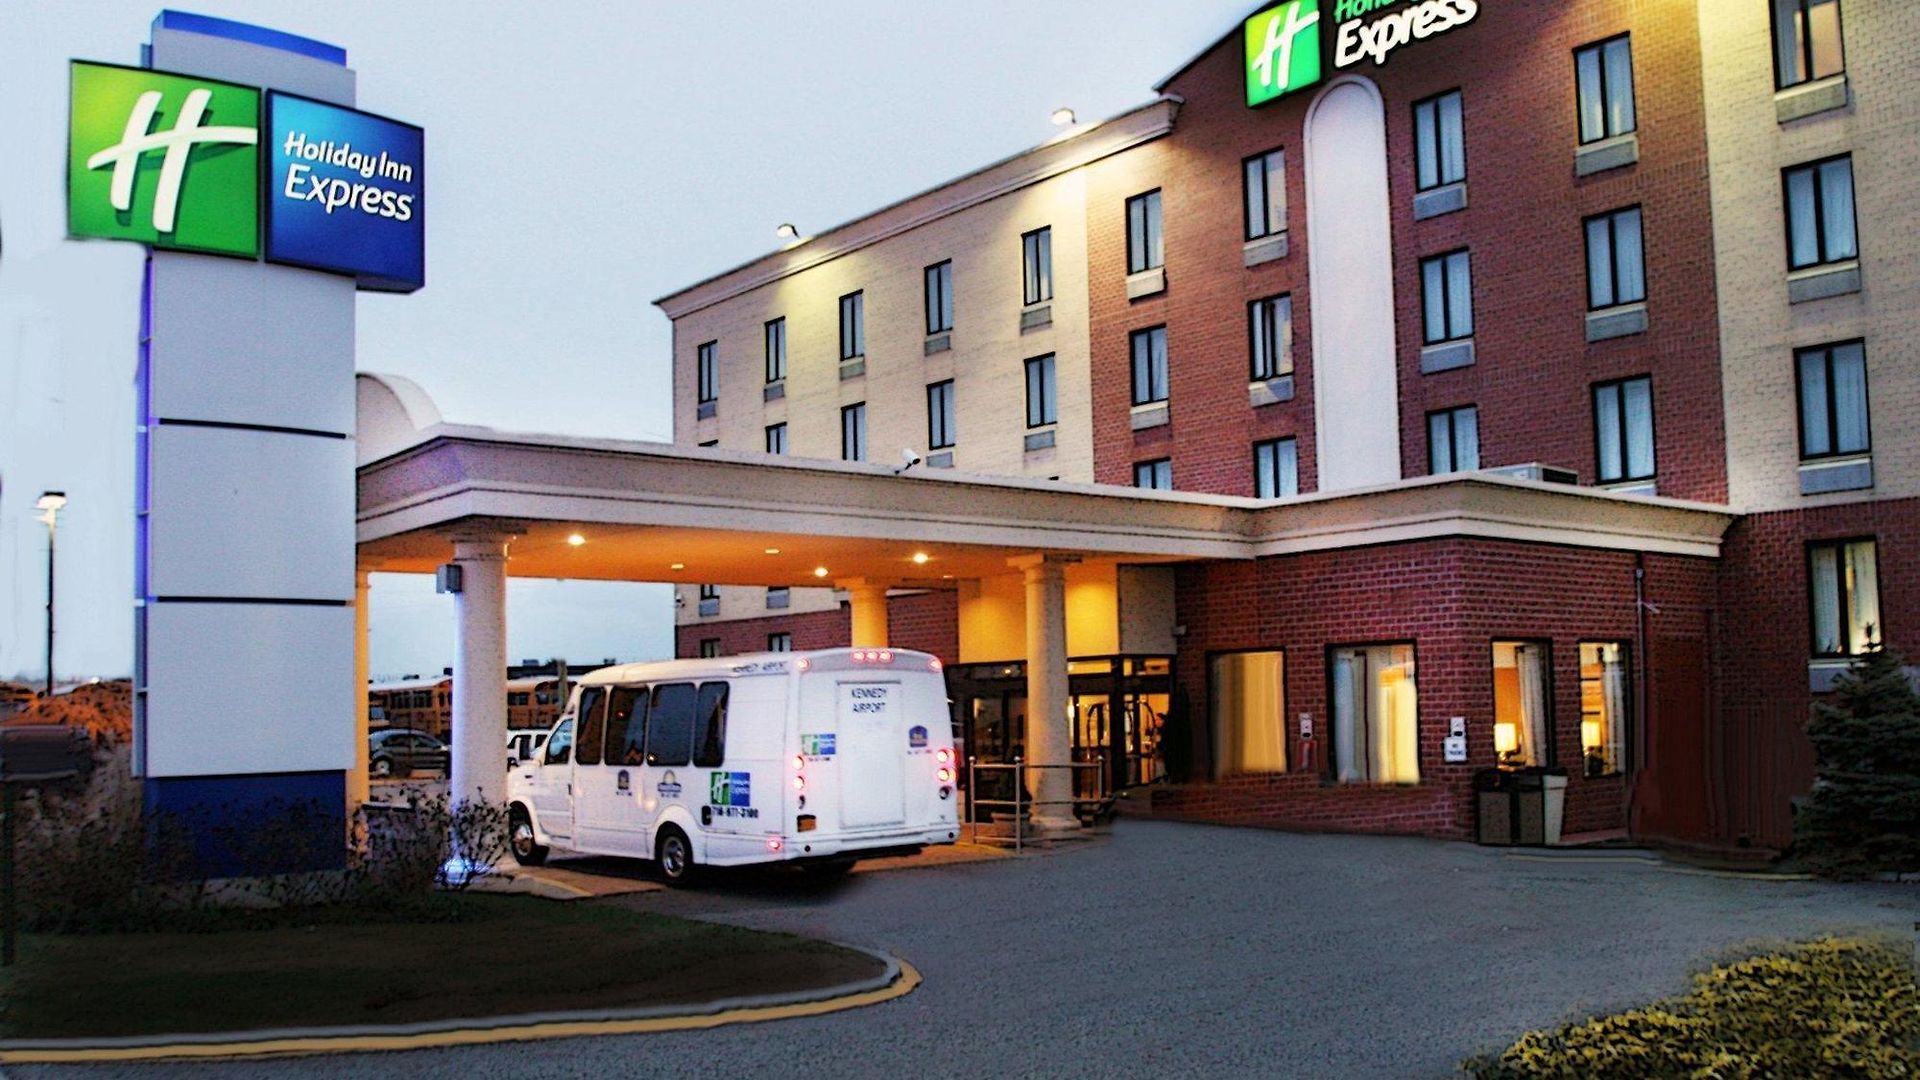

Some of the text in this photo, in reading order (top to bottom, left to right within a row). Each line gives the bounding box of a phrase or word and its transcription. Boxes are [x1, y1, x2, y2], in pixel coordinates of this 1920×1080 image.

[1335, 0, 1478, 67] Express
[284, 130, 412, 183] Holiday Inn
[284, 163, 413, 221] Express
[851, 688, 887, 699] KENNEDY
[852, 702, 886, 713] AIRPORT
